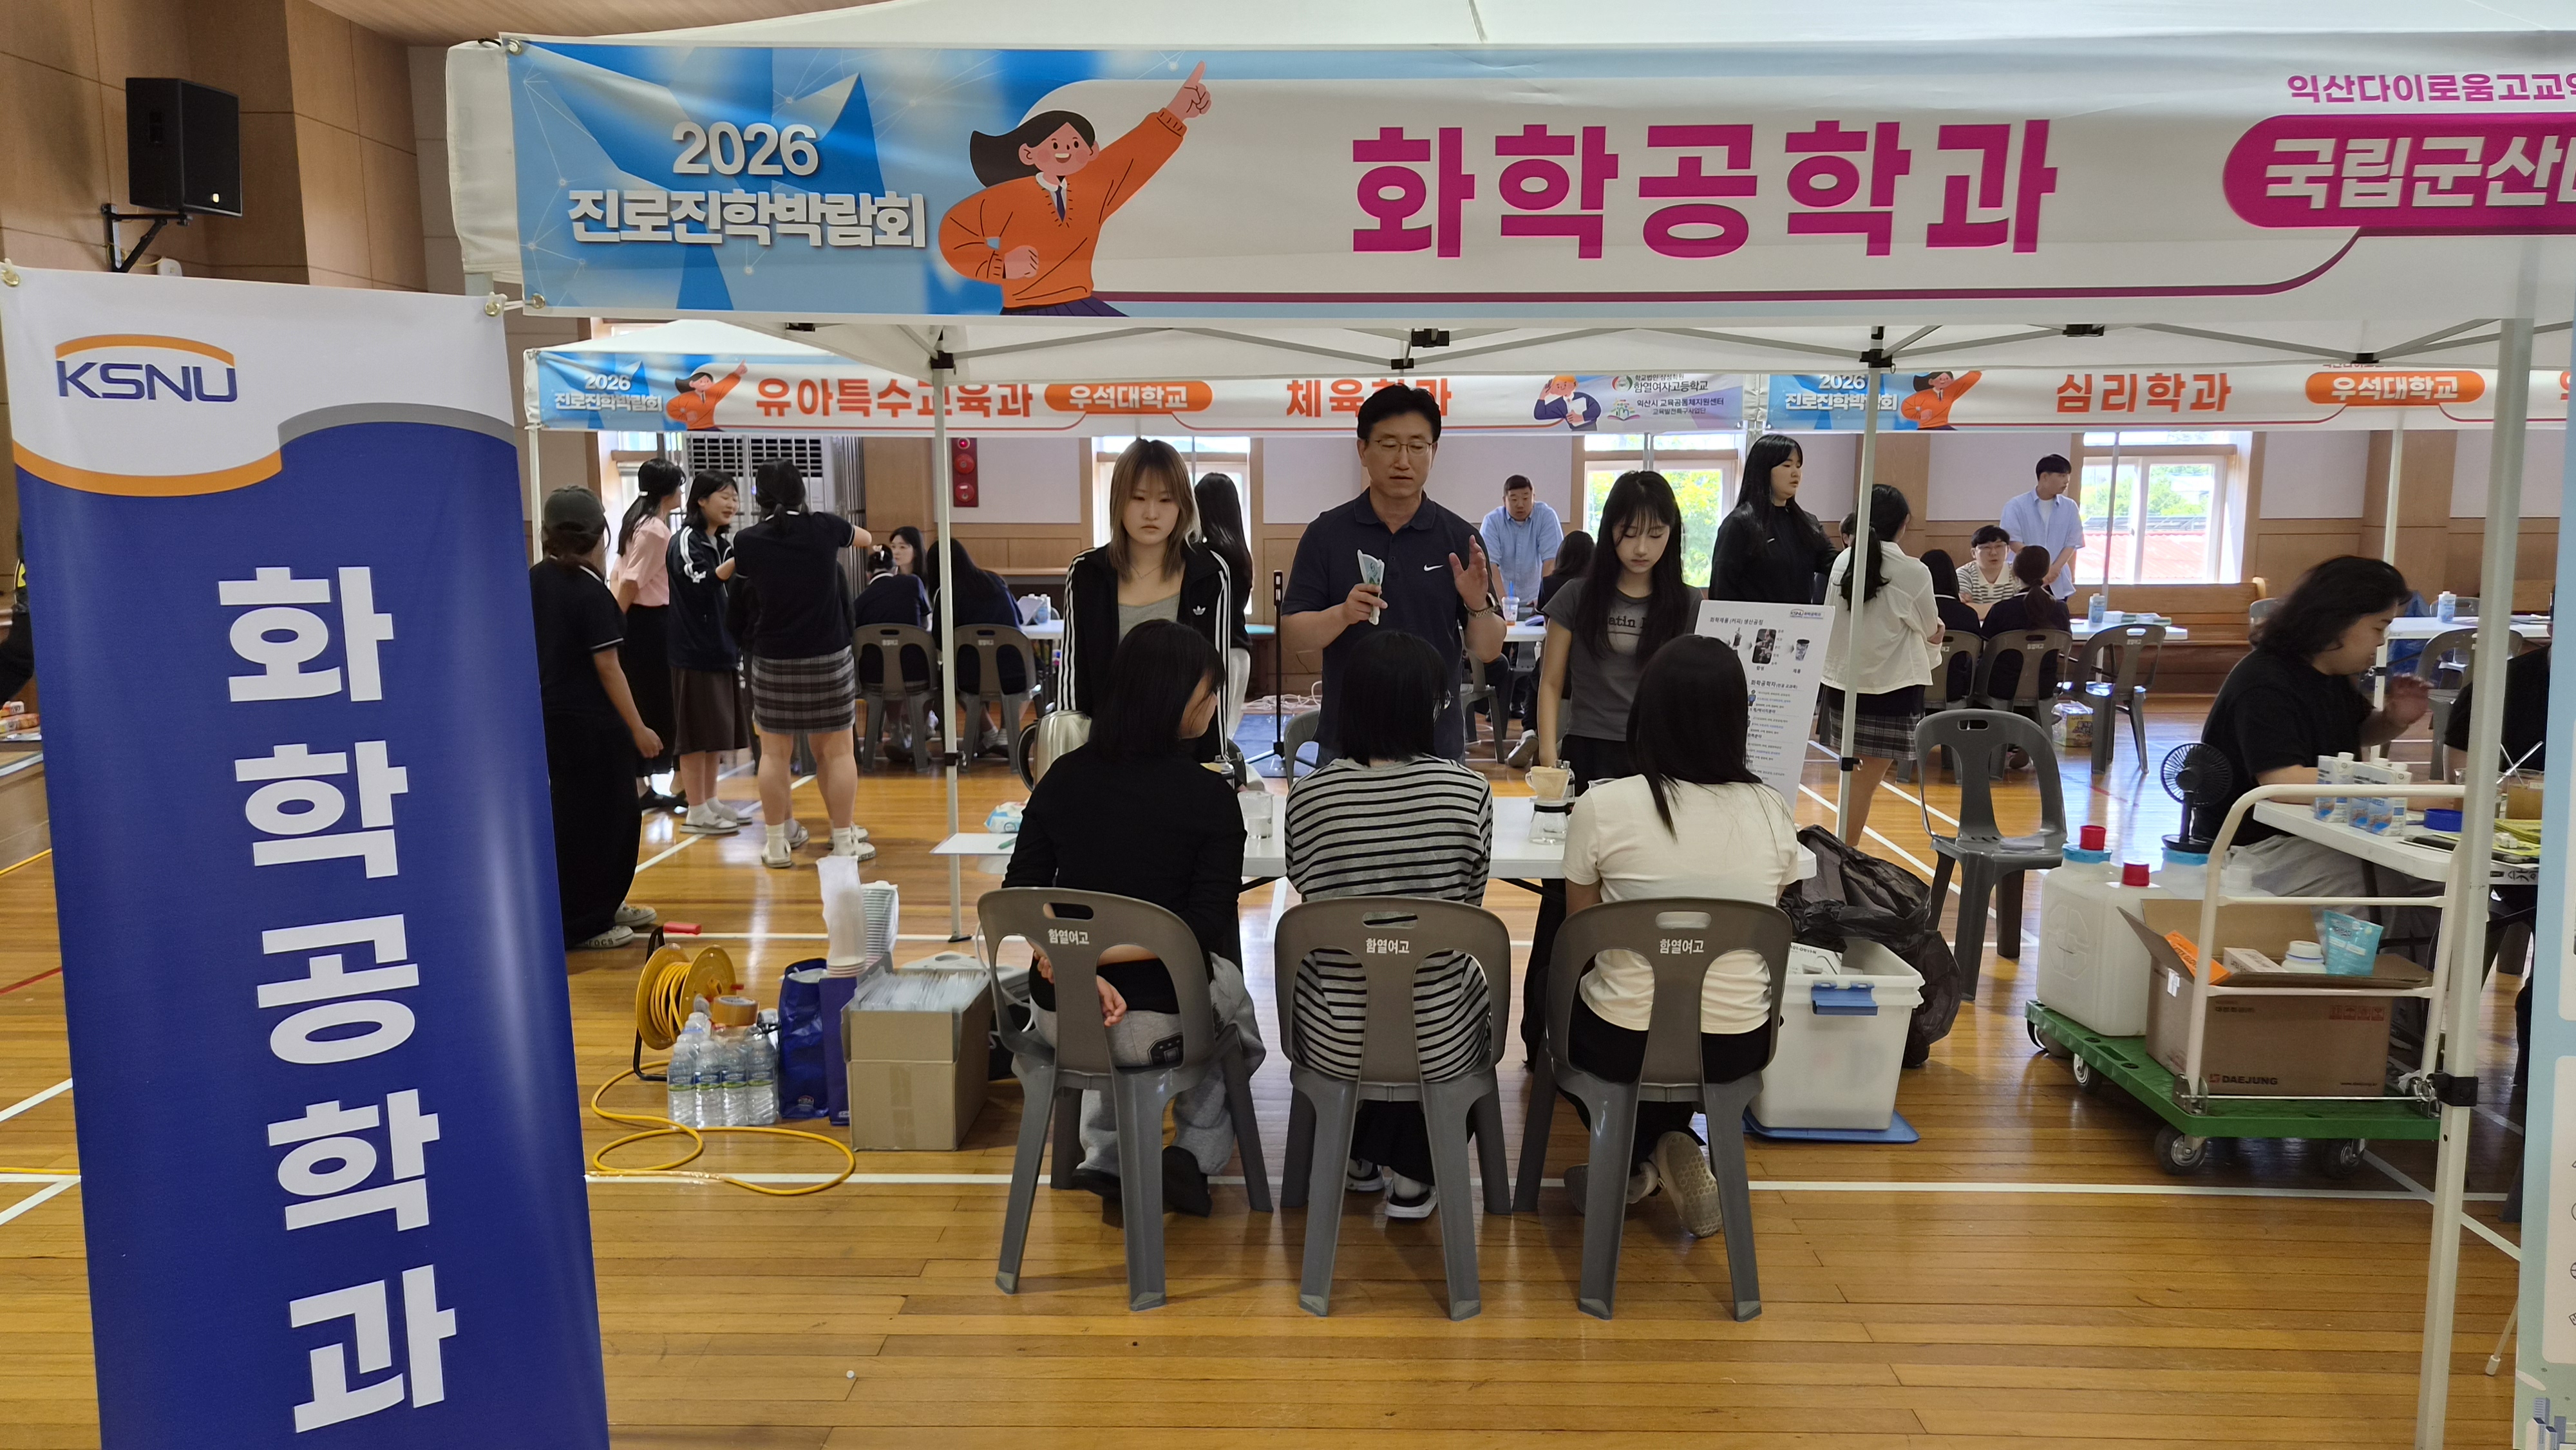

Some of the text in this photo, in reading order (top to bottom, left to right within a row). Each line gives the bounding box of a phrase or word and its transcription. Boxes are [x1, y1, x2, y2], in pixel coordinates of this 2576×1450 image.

[672, 120, 819, 176] 2026
[1352, 118, 2058, 259] 화학공학과
[567, 189, 926, 248] 진로진학박람회
[57, 359, 237, 402] KSNU
[584, 373, 631, 391] 2026
[1633, 381, 1709, 393] 함열여자고등학교
[1818, 374, 1866, 390] 2026
[2331, 376, 2459, 401] 우석대학교
[554, 392, 663, 413] 진로진학박람회
[1068, 384, 1188, 410] 우석대학교
[1286, 378, 1452, 417] 체육과
[1785, 393, 1899, 411] 진로진학박회
[2056, 373, 2231, 413] 심리학과
[1636, 399, 1658, 408] 익산시
[1608, 615, 1636, 628] atin
[1048, 928, 1090, 946] 함열여고
[1366, 937, 1410, 955] 함열여고
[1659, 938, 1705, 956] 함열여고
[218, 566, 457, 1433] 화학공학과
[2222, 1075, 2278, 1085] DAEJUNG
